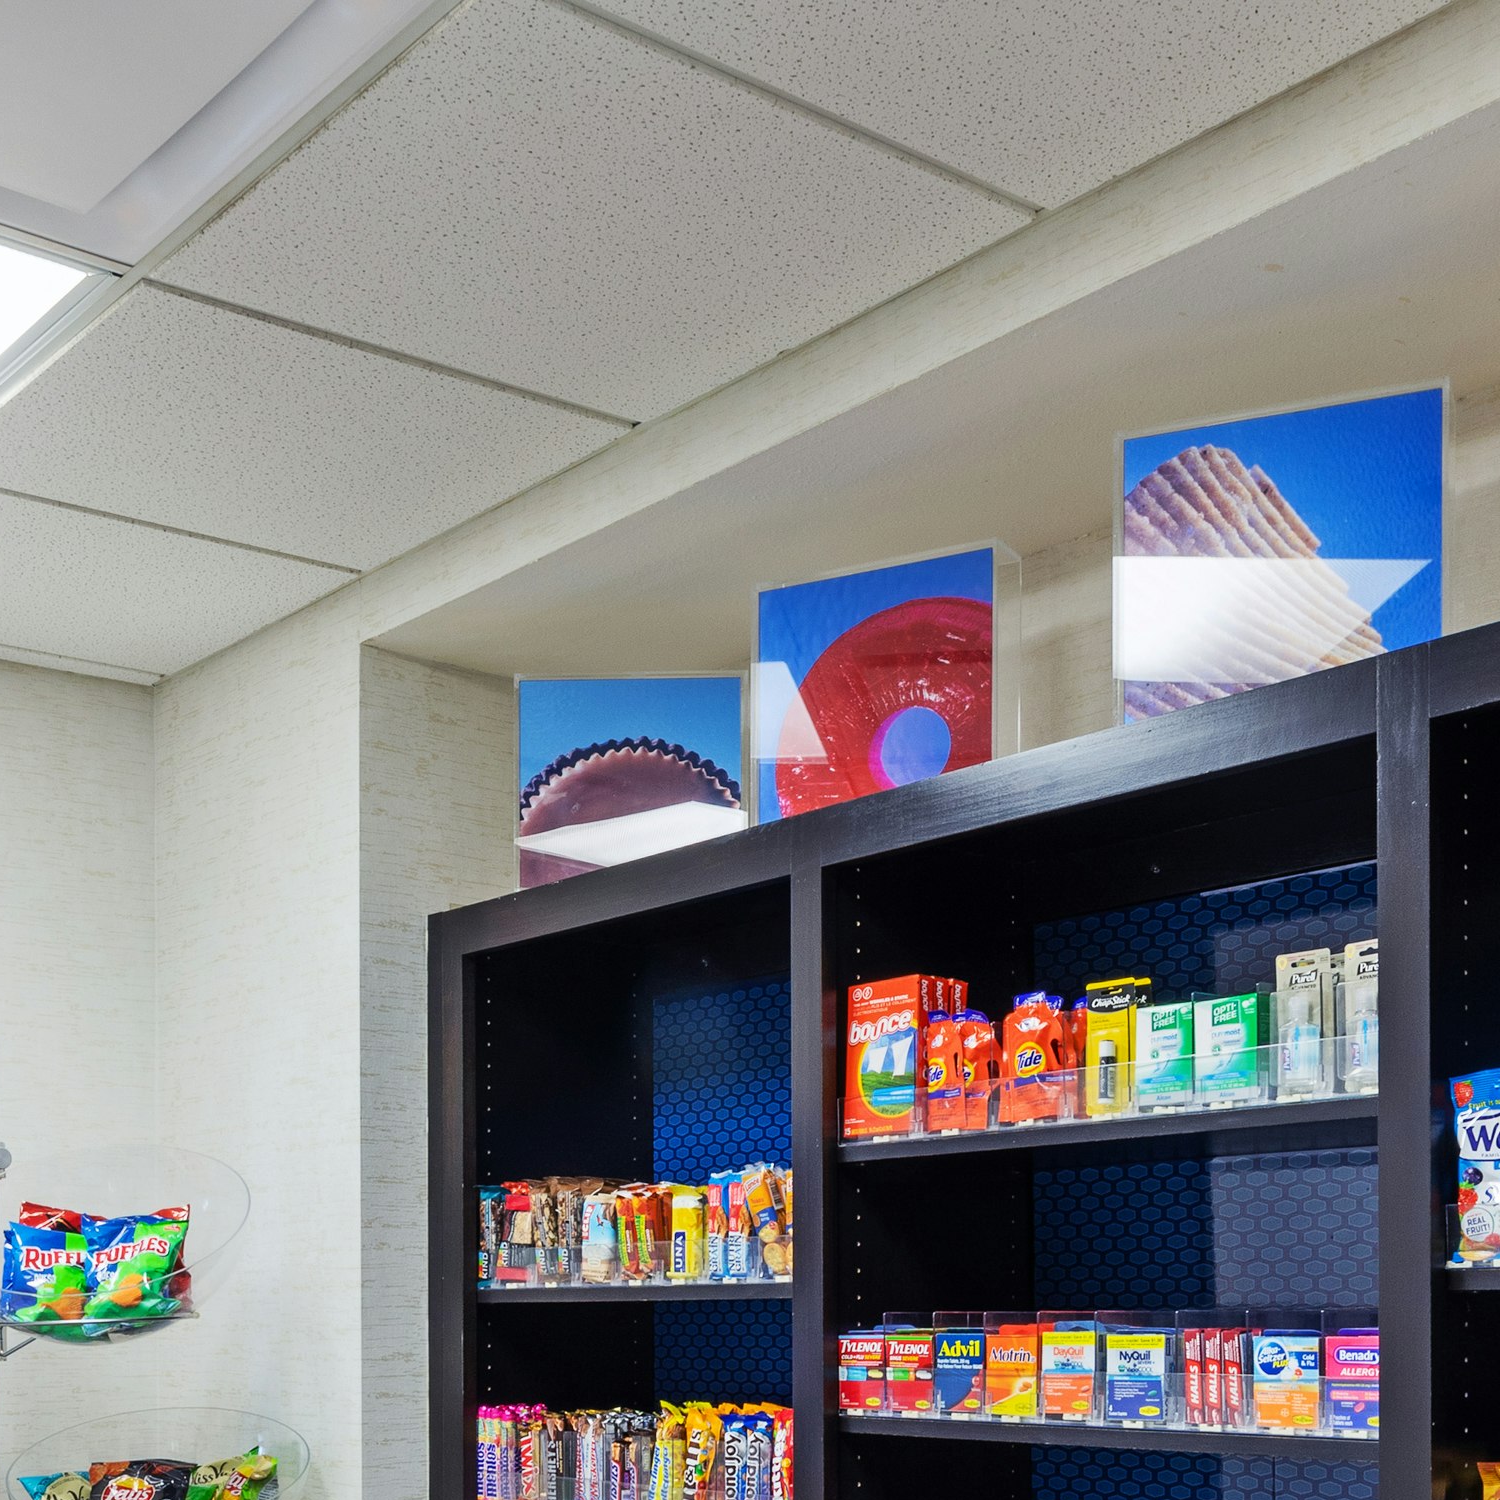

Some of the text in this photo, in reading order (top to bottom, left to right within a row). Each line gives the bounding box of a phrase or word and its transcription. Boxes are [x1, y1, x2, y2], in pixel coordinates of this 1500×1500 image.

[1291, 971, 1316, 984] Purell
[921, 979, 929, 1011] bounce
[1091, 994, 1130, 1009] ChapStick
[1213, 1002, 1237, 1016] OPTI-
[1153, 1018, 1176, 1030] FREE
[1213, 1011, 1237, 1024] FREE
[850, 1010, 913, 1045] bounce
[1017, 1050, 1042, 1071] Tide
[1467, 1217, 1487, 1227] REAL
[1466, 1225, 1490, 1236] FRUIT!
[501, 1241, 509, 1267] KIND
[841, 1340, 882, 1354] TYLENOL
[889, 1341, 929, 1355] TYLENOL
[938, 1340, 980, 1357] Advil
[1054, 1347, 1084, 1358] DayQuil
[989, 1347, 1031, 1362] Motrin
[1120, 1351, 1151, 1363] NyQuil
[1258, 1352, 1286, 1364] Seltzer
[1302, 1353, 1315, 1361] Cold
[1272, 1360, 1289, 1369] PLUS
[1340, 1367, 1379, 1376] ALLERGY
[1189, 1364, 1199, 1405] HALLS
[1208, 1363, 1218, 1404] HALLS
[1228, 1367, 1239, 1406] HALLS
[486, 1443, 497, 1497] mentos
[520, 1431, 533, 1497] TWIX
